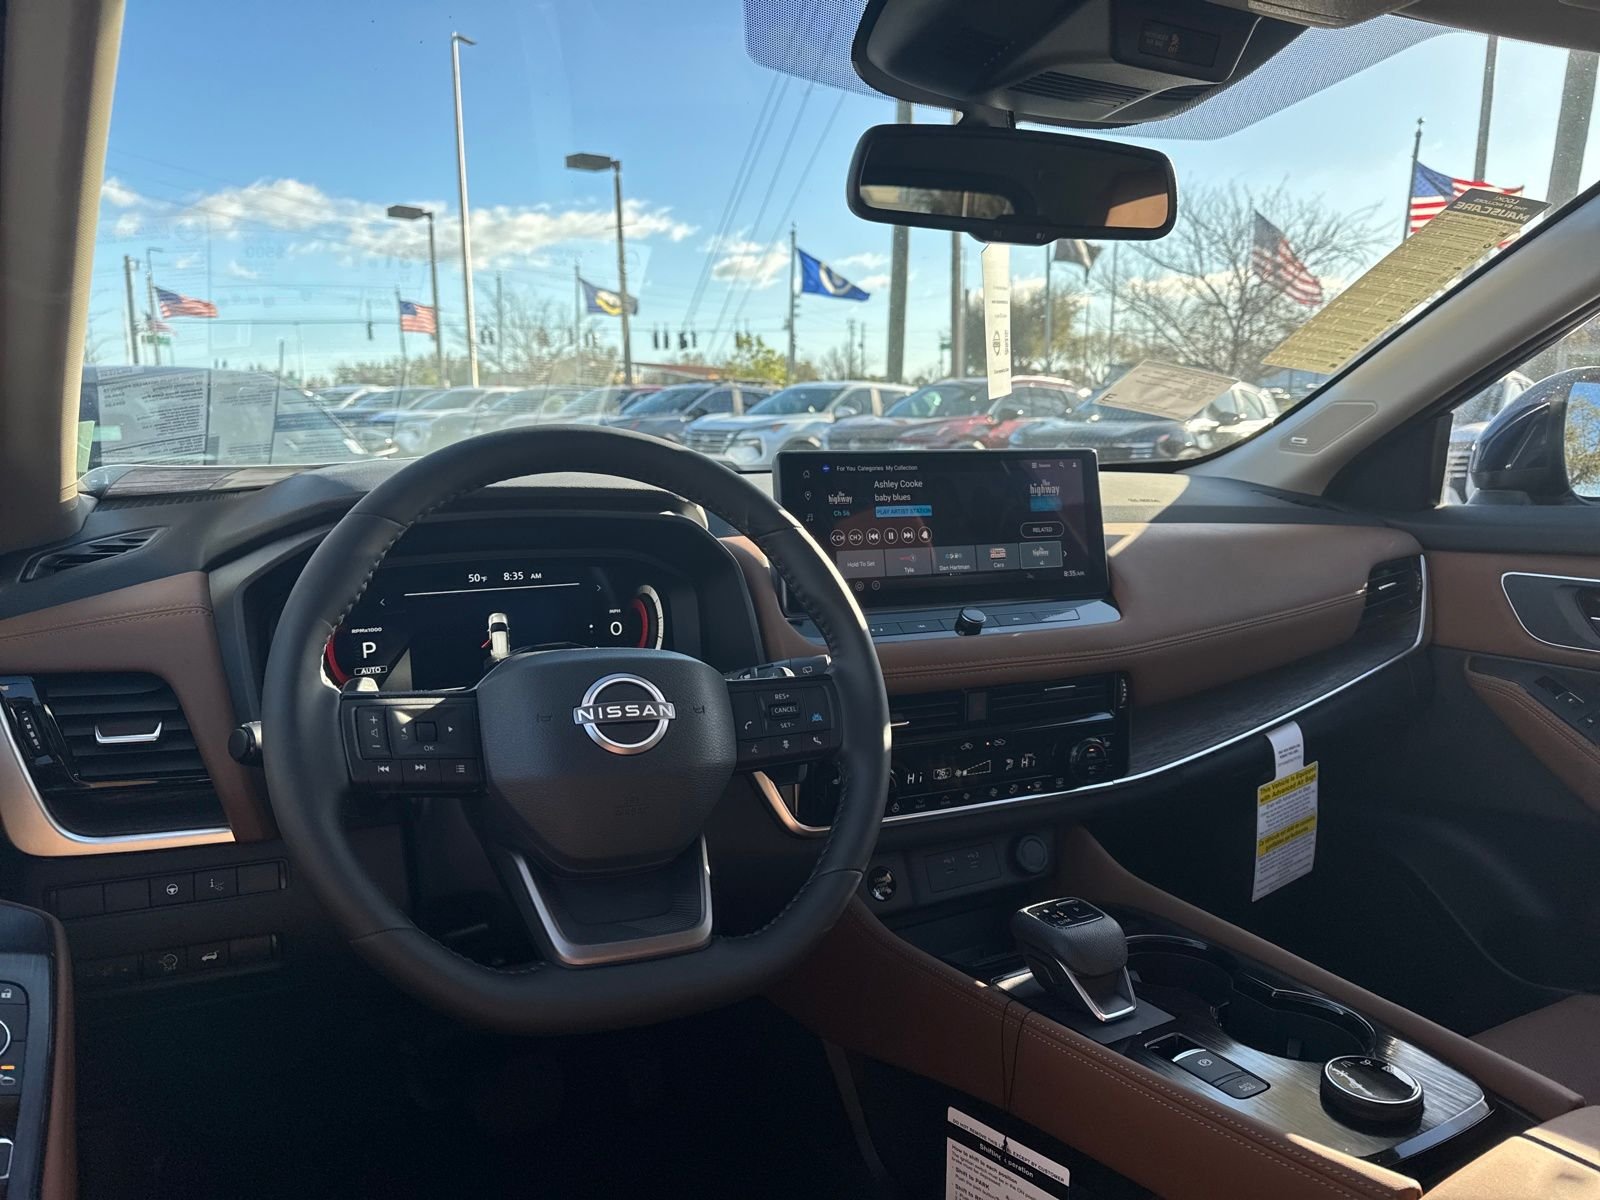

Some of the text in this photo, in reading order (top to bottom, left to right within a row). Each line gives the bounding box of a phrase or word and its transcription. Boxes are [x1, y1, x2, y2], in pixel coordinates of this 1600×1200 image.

[874, 480, 923, 489] Ashley Cooke
[1030, 483, 1060, 496] highway
[828, 494, 853, 504] highway
[874, 493, 911, 502] baby blues
[504, 571, 524, 581] 8:35
[610, 621, 622, 636] 0
[362, 641, 376, 658] P
[577, 704, 673, 721] NISSAN
[907, 772, 922, 784] Hi
[1013, 1151, 1030, 1164] EXCEPT
[1038, 1165, 1064, 1182] CUSTOMER
